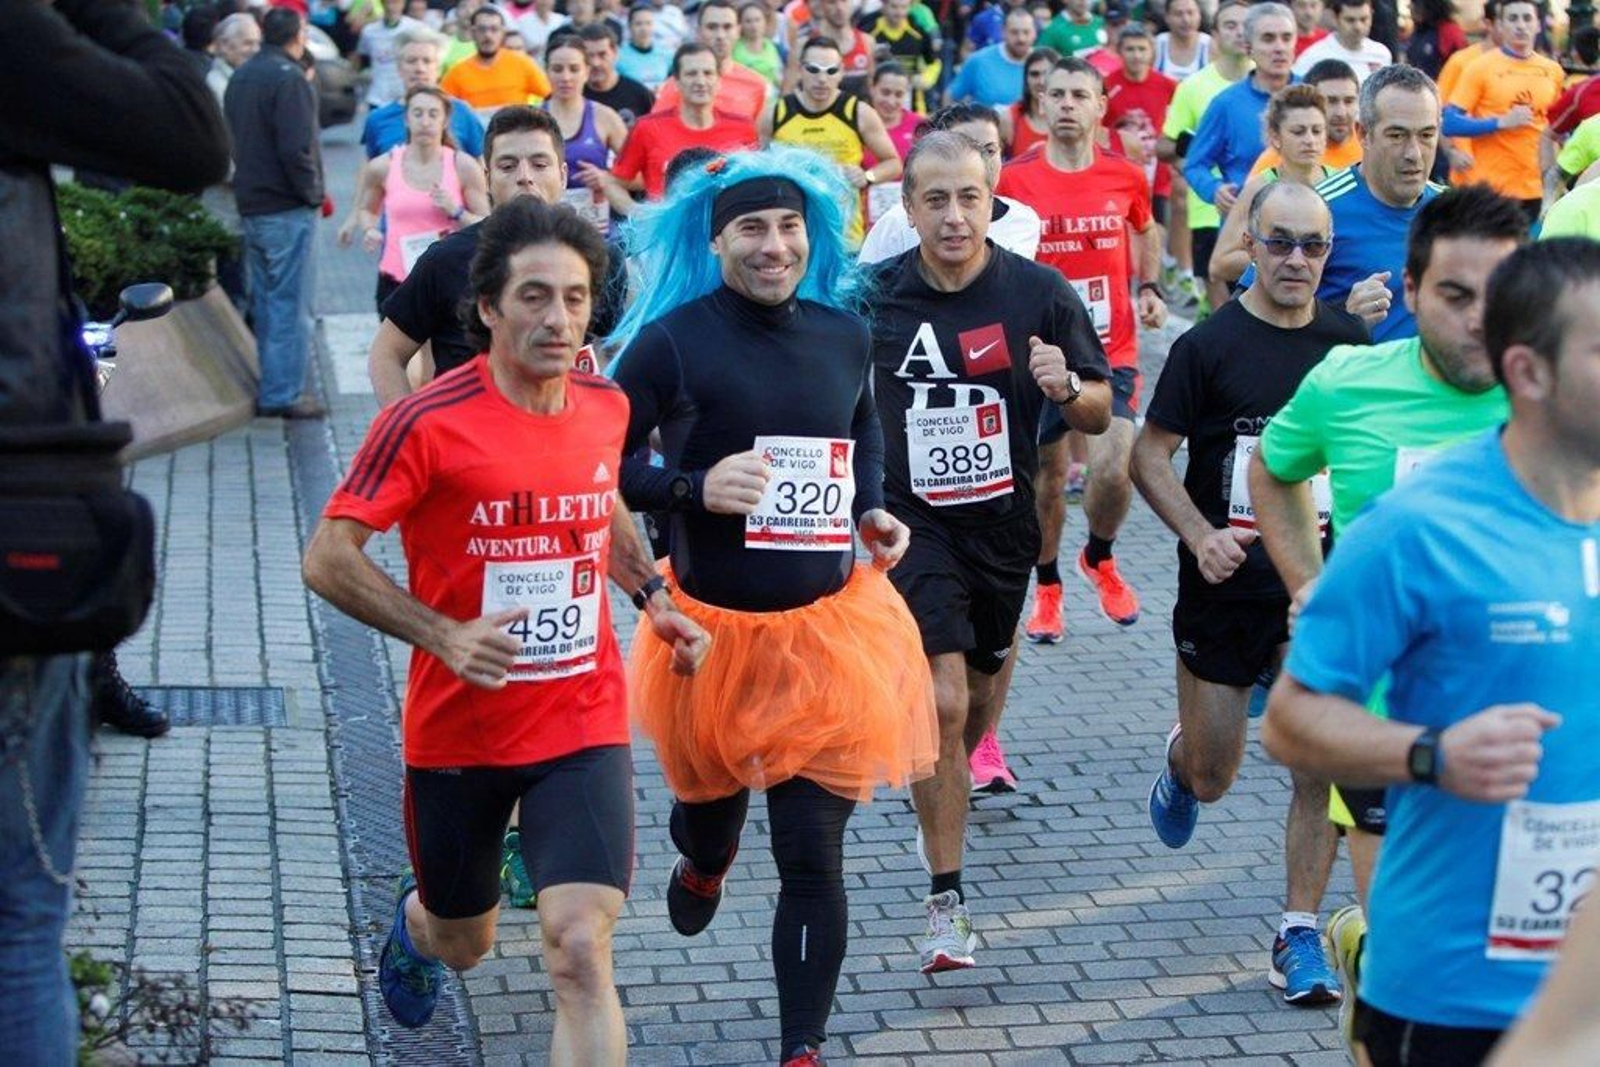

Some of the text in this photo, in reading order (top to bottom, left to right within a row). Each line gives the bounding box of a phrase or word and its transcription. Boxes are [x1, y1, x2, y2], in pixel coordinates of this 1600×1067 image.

[893, 322, 958, 378] A
[916, 416, 970, 428] CONCELLO
[923, 425, 965, 437] DE VIGO
[764, 446, 824, 458] CONCELLO
[928, 442, 993, 476] 389
[770, 459, 816, 469] DE VIGO
[913, 466, 1010, 488] 53 CARREIRA DO PAVO
[775, 481, 842, 516] 320
[1231, 504, 1245, 515] 53
[749, 515, 764, 526] 53
[766, 515, 816, 528] CARREIRA
[466, 535, 562, 557] AVENTURA
[497, 570, 565, 585] CONCELLO
[505, 584, 557, 596] DE VIGO
[508, 604, 581, 643] 459
[1532, 866, 1600, 915] 32
